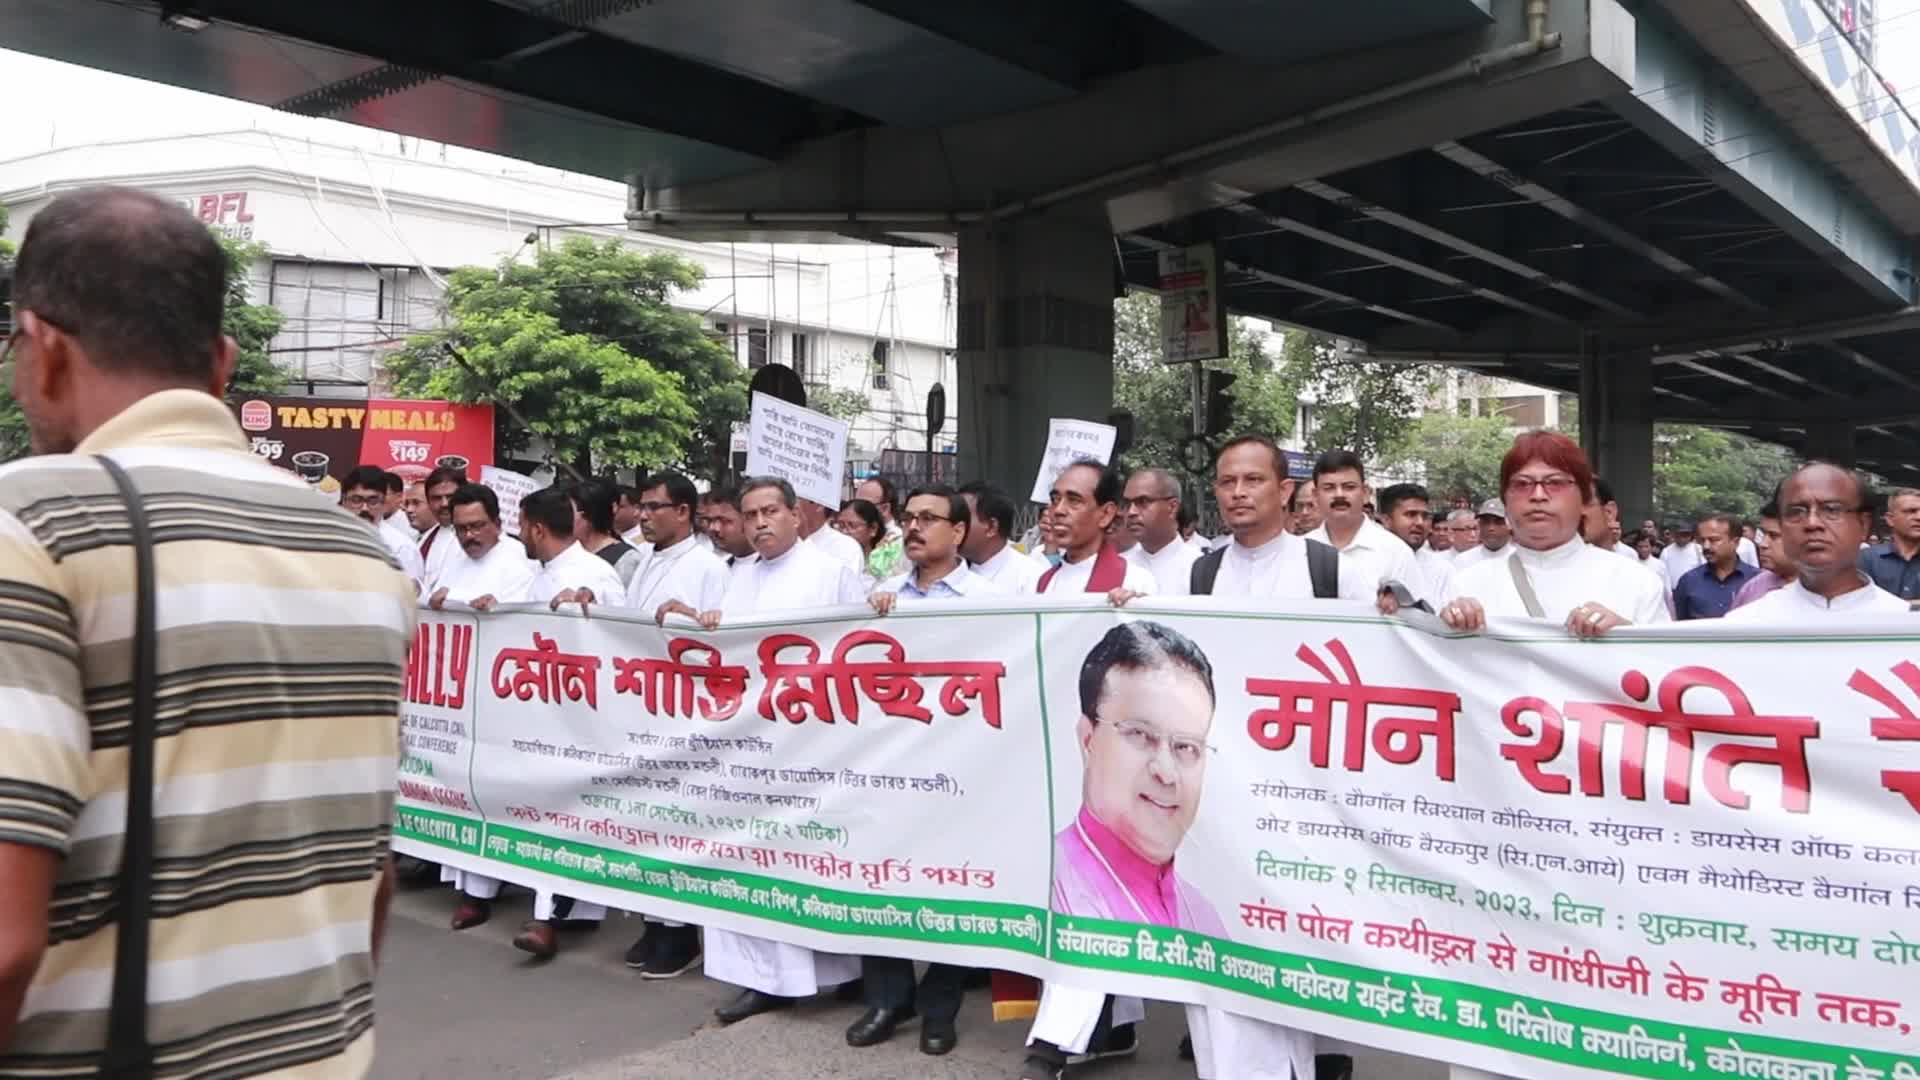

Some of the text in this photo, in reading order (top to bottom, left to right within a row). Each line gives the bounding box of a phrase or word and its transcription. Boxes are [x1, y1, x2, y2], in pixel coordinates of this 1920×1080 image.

[200, 192, 254, 224] BFL
[277, 407, 456, 432] TASTY MEALS
[390, 446, 428, 462] ₹149
[405, 623, 473, 710] ALLY
[491, 632, 602, 711] মৌন
[757, 630, 1006, 729] মিছিল
[1246, 638, 1462, 782] मौन
[1500, 666, 1819, 814] शांति
[870, 774, 906, 791] ভারত
[1251, 780, 1328, 803] संयोजक
[1589, 817, 1663, 845] संयुक्त
[1690, 828, 1780, 855] डायसेस
[1792, 834, 1853, 860] ऑफ
[1863, 845, 1920, 866] कल
[705, 814, 746, 831] ২০২৩
[784, 824, 794, 838] ২
[799, 820, 849, 848] ঘটিকা)
[783, 850, 852, 878] গান্ধীর
[922, 862, 995, 889] পর্যন্ত
[1297, 819, 1364, 840] डायसेस
[1370, 826, 1413, 849] ऑफ
[1638, 864, 1688, 886] एवम
[1699, 864, 1804, 898] मैथोडिस्ट
[1813, 876, 1892, 906] बैगांल
[916, 906, 954, 932] (উত্তর
[958, 915, 997, 934] ভারত
[1255, 850, 1336, 884] दिनांक
[1368, 863, 1464, 907] सितम्बर,
[1552, 892, 1604, 928] दिन
[1638, 911, 1756, 951] शुक्रवार,
[1770, 928, 1860, 961] समय
[1055, 922, 1131, 958] संचालक
[1221, 954, 1276, 989] अध्यक्ष
[1281, 963, 1350, 1003] महोदय
[1355, 976, 1406, 1018] राईट
[1411, 981, 1447, 1021] रेव.
[1456, 999, 1487, 1030] डा.
[1496, 1001, 1574, 1049] परितोष
[1240, 897, 1287, 933] संत
[1297, 904, 1352, 945] पोल
[1364, 917, 1476, 966] कथीड्रल
[1487, 932, 1517, 972] से
[1528, 946, 1650, 996] गांधीजी
[1664, 960, 1709, 1003] के
[1816, 993, 1912, 1036] तक,
